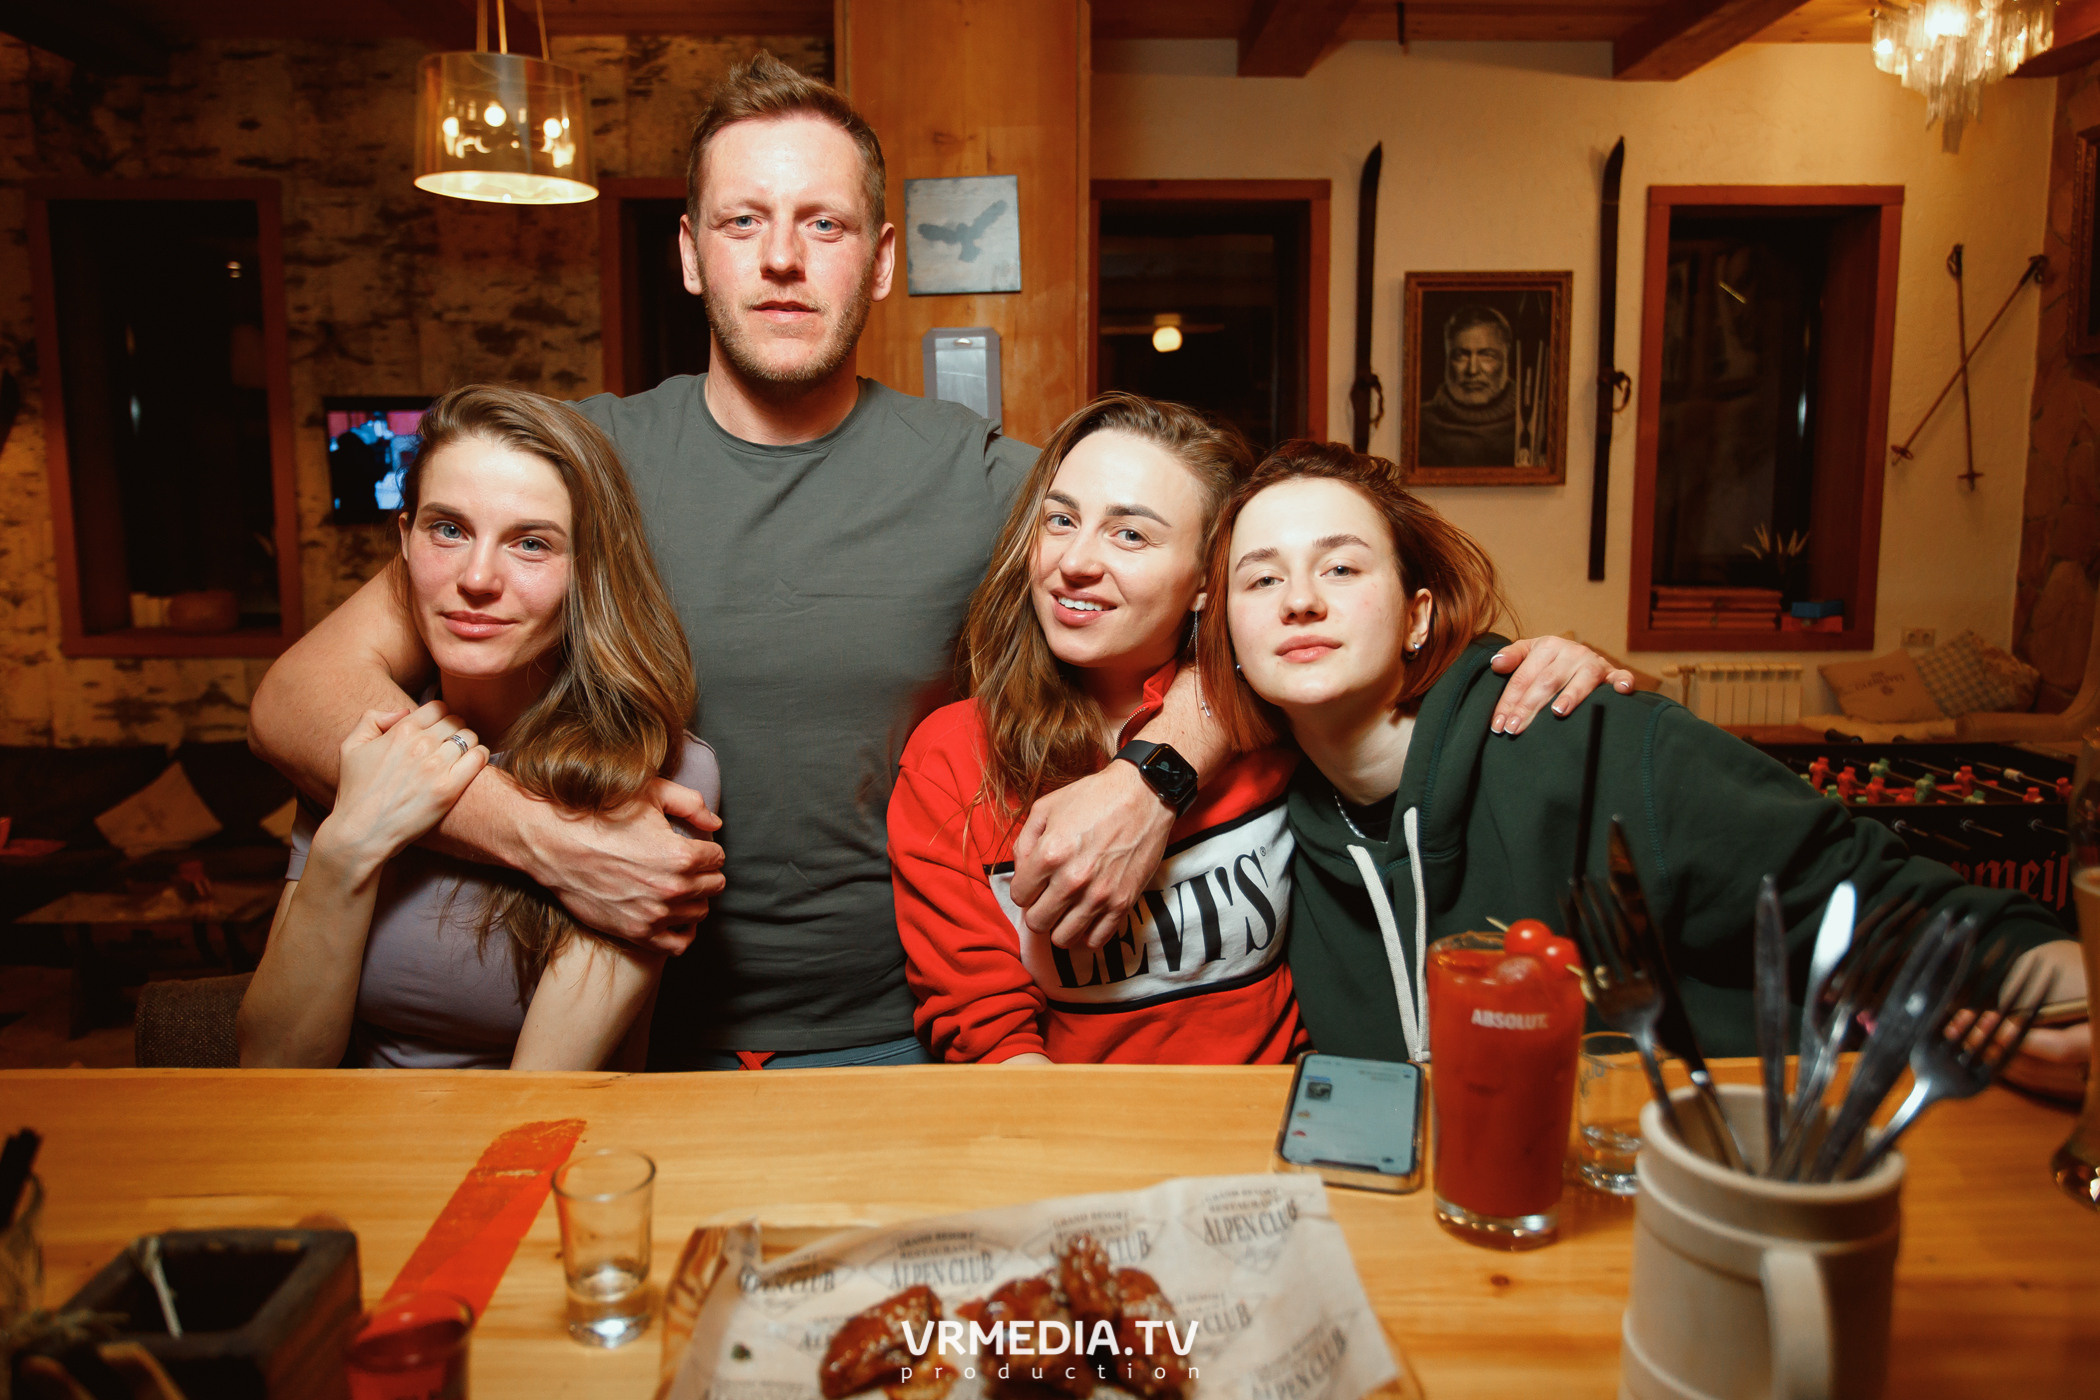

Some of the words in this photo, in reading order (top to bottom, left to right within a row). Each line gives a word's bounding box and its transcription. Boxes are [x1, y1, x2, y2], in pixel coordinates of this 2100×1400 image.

[1203, 1214, 1258, 1246] ALPEN
[1258, 1198, 1298, 1237] CLUB
[1106, 1230, 1151, 1264] CLUB
[888, 1260, 945, 1290] ALPEN
[948, 1248, 996, 1285] CLUB
[1203, 1302, 1253, 1335] CLUB
